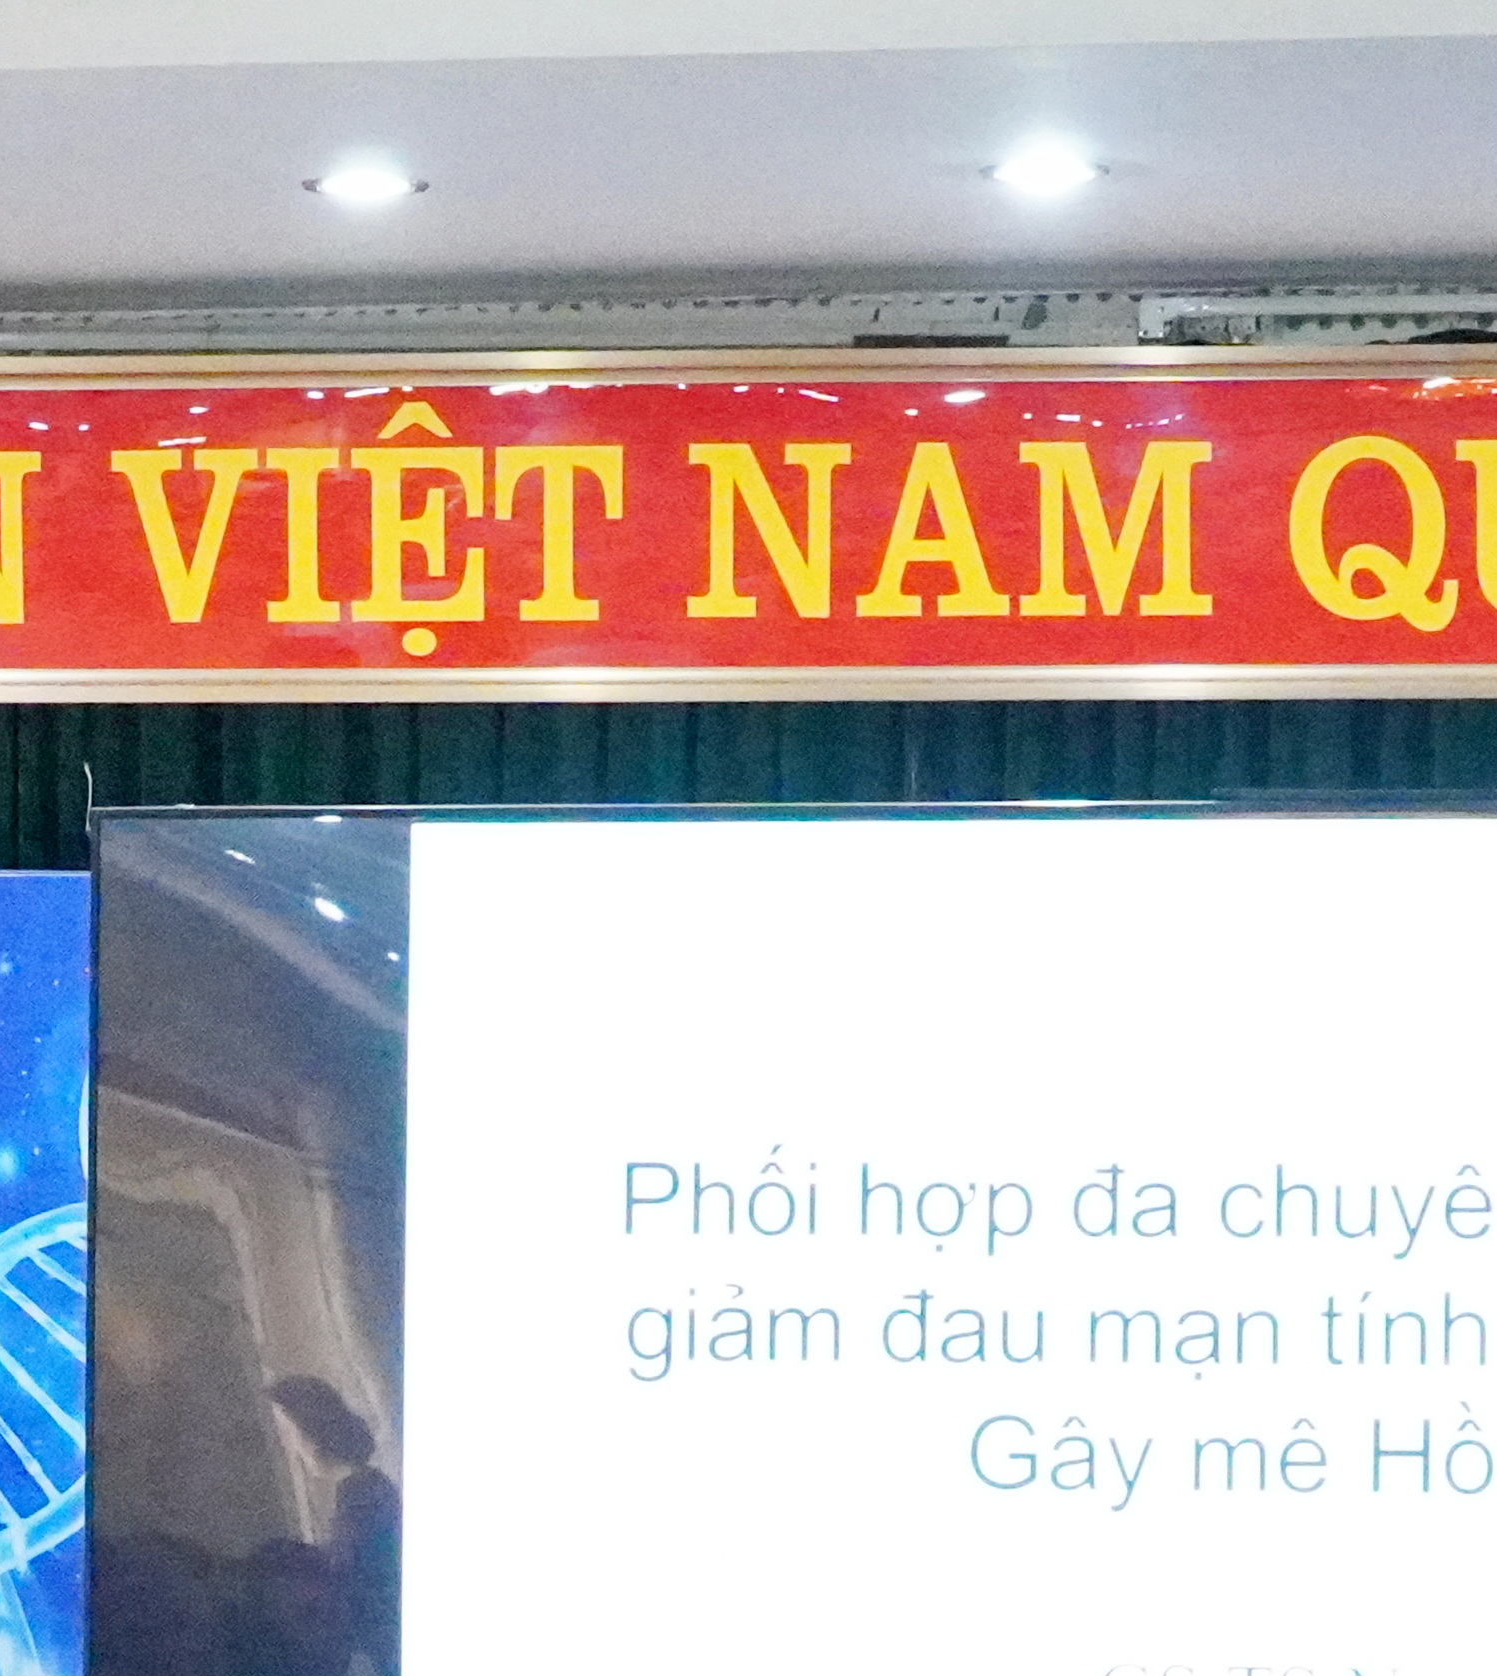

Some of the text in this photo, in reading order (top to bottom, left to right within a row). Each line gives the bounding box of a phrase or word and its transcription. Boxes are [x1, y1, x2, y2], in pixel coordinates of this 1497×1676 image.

[109, 400, 625, 658] VIỆT
[685, 440, 1214, 620] NAM
[624, 1144, 819, 1240] Phối
[859, 1163, 1036, 1259] hợp
[1072, 1162, 1179, 1240] đa
[627, 1283, 843, 1385] giảm
[881, 1288, 1047, 1366] đau
[1088, 1309, 1282, 1383] mạn
[1320, 1290, 1489, 1369] tính
[969, 1414, 1155, 1515] Gây
[1193, 1416, 1330, 1496] mê
